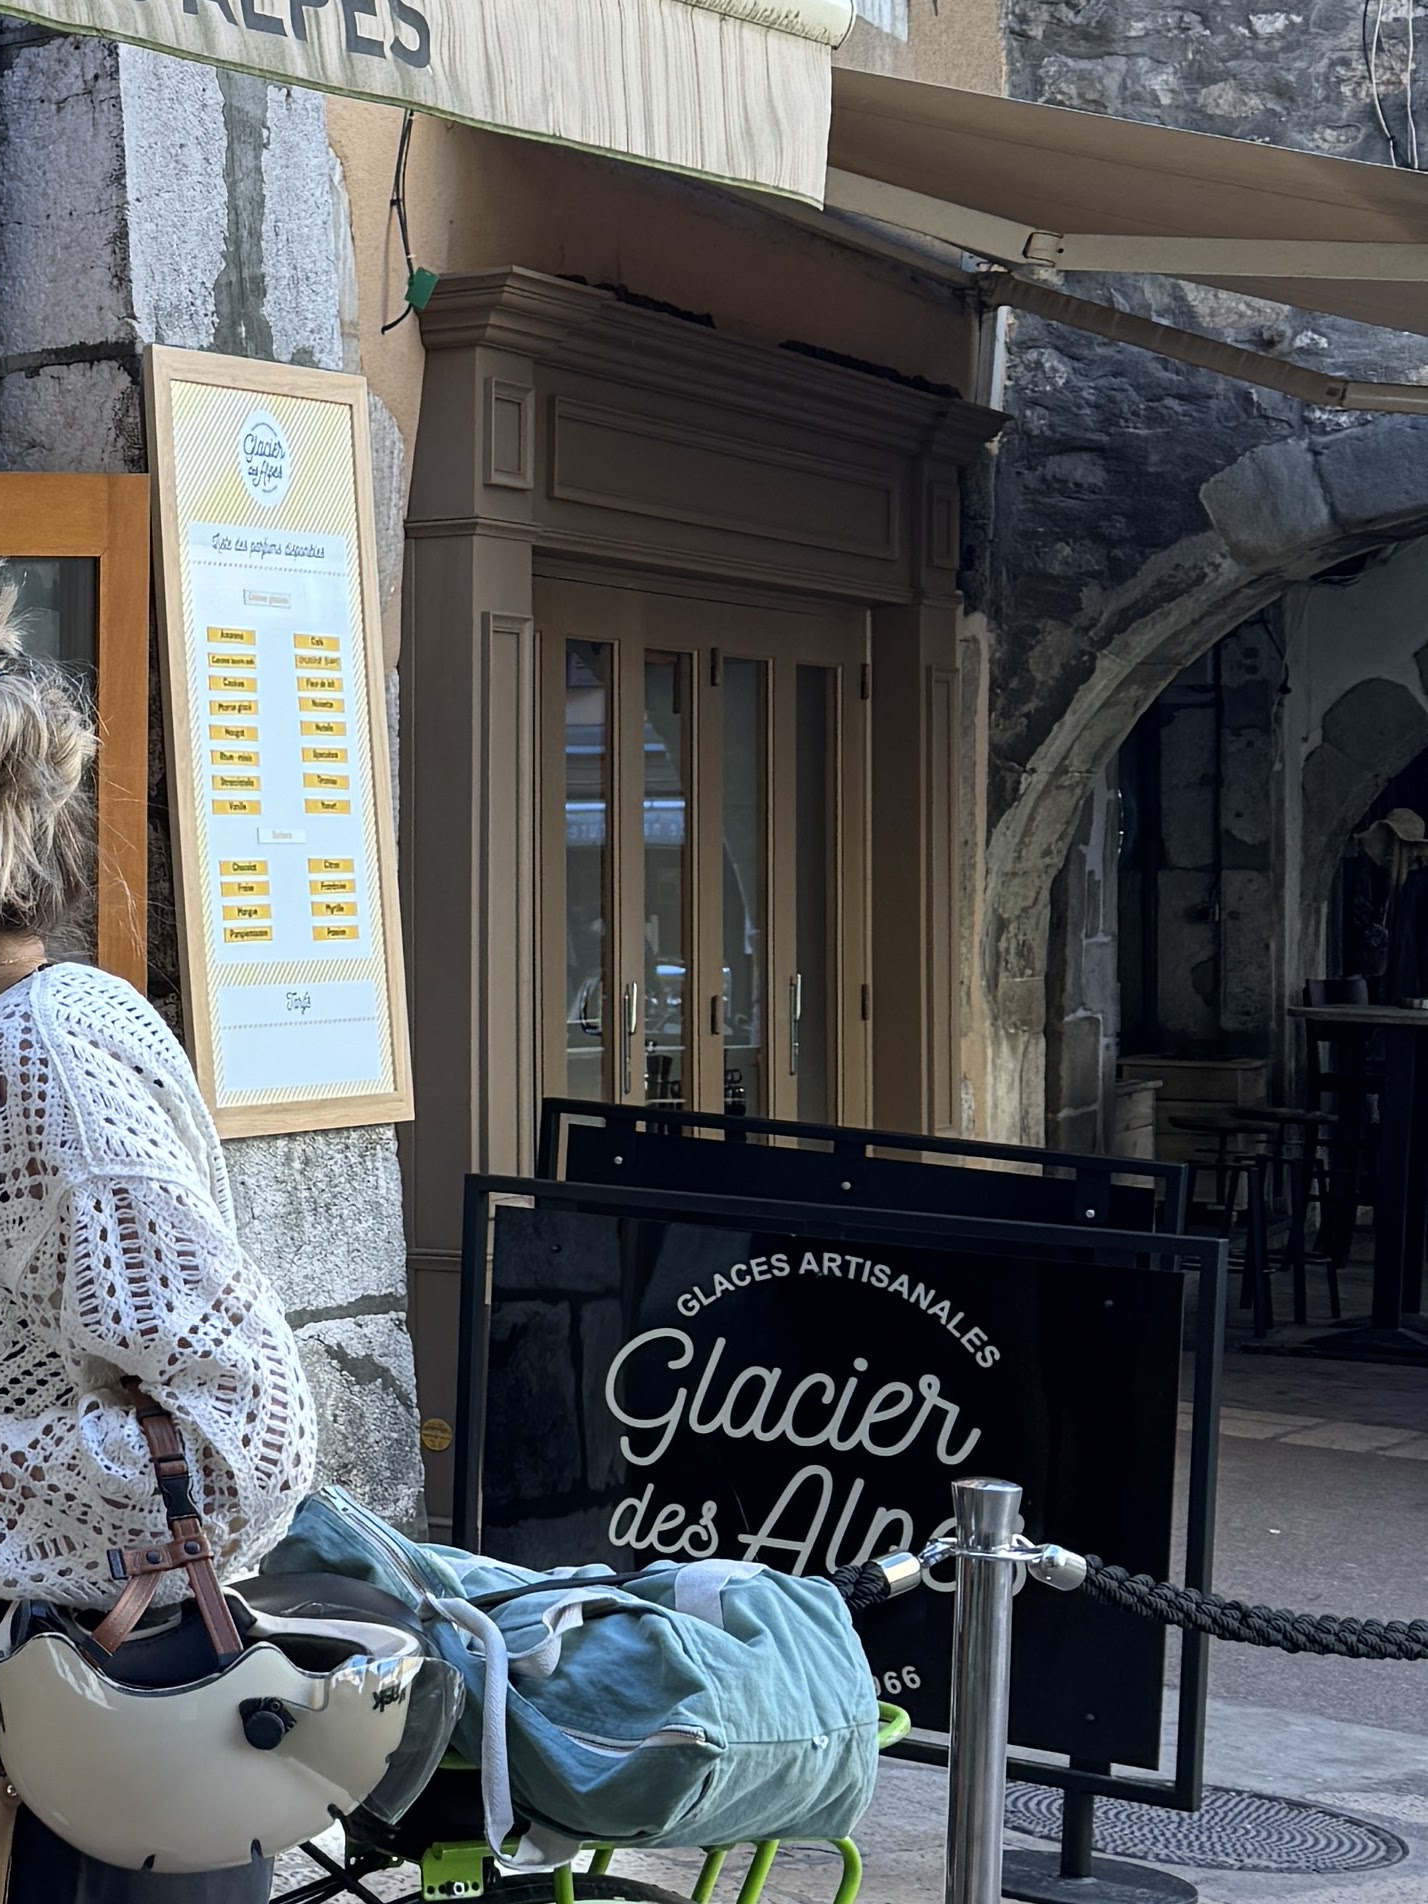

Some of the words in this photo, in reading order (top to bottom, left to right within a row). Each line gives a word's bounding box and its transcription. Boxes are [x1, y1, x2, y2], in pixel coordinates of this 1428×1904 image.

[244, 433, 286, 463] Glacier
[678, 1254, 790, 1316] GLACES
[799, 1252, 1000, 1371] ARTISANALES
[604, 1327, 983, 1466] Glacier
[609, 1484, 718, 1556] des
